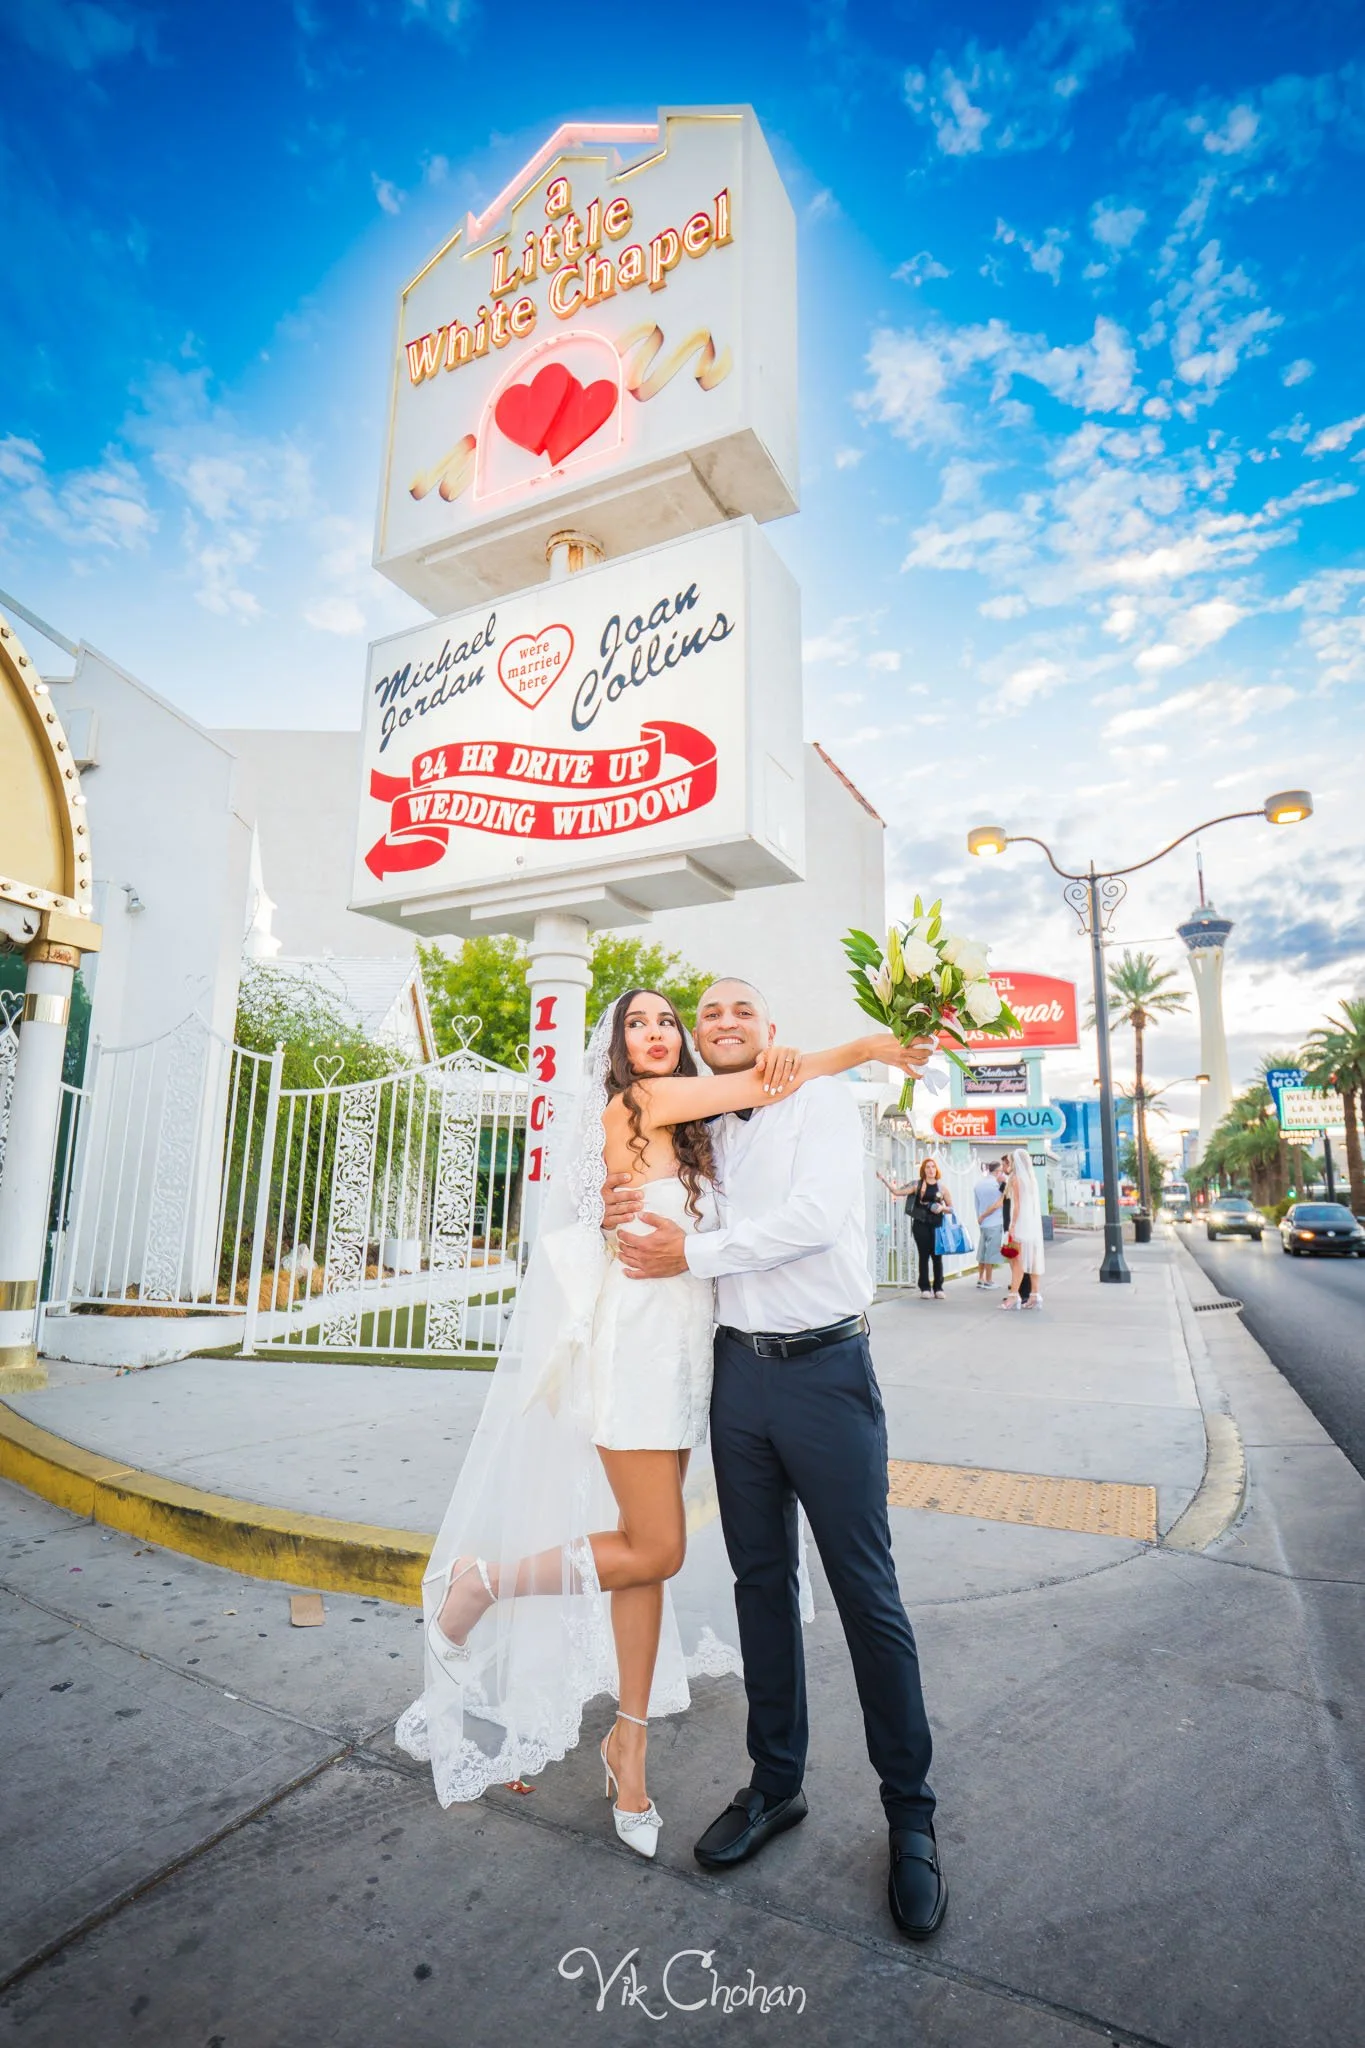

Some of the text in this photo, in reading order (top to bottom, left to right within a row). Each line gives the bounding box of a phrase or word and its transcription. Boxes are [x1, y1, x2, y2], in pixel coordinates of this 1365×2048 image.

[545, 176, 571, 217] a
[489, 197, 632, 298] Little
[405, 187, 734, 386] White Chapel
[519, 642, 549, 659] were
[600, 583, 700, 678] Joan
[374, 612, 497, 708] Michael
[508, 651, 561, 679] married
[571, 612, 735, 732] Collins
[519, 675, 548, 692] here
[379, 666, 486, 753] Jordan
[419, 744, 650, 784] 24 HR DRIVE UP
[407, 777, 694, 835] WEDDING WINDOW
[989, 977, 1015, 991] TEL
[1271, 1078, 1304, 1088] MOT
[942, 1123, 989, 1136] HOTEL
[1000, 1112, 1054, 1127] AQUA
